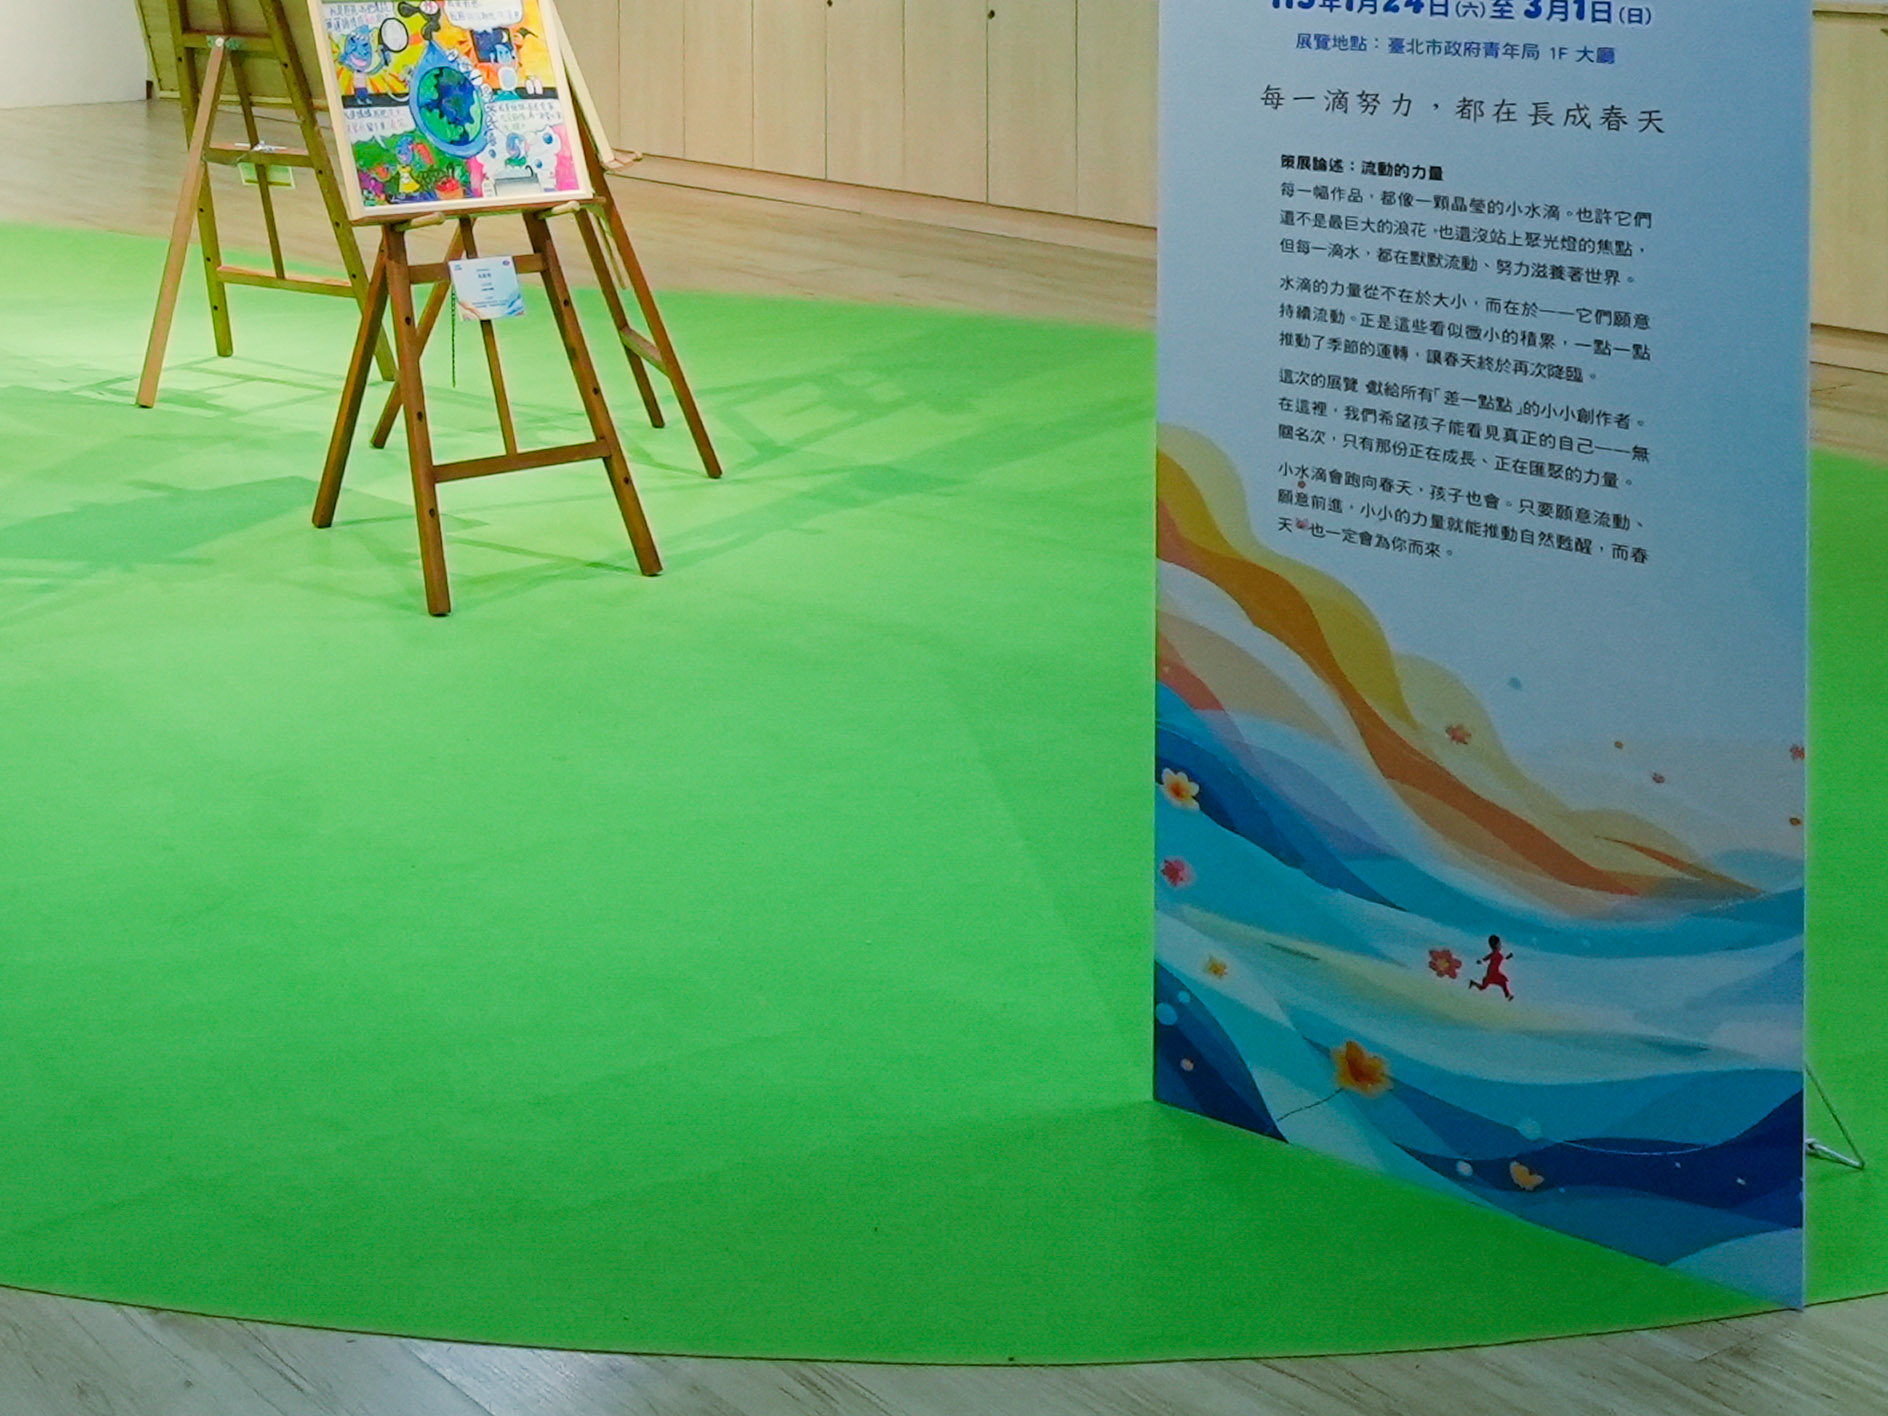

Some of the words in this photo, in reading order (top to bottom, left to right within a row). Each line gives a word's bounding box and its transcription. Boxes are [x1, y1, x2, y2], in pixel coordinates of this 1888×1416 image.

[1549, 46, 1569, 61] 1F
[1574, 45, 1616, 65] 大廳
[1259, 84, 1666, 135] 每一滴努力，都在長成春天
[1280, 153, 1445, 182] 策展論述：流動的力量
